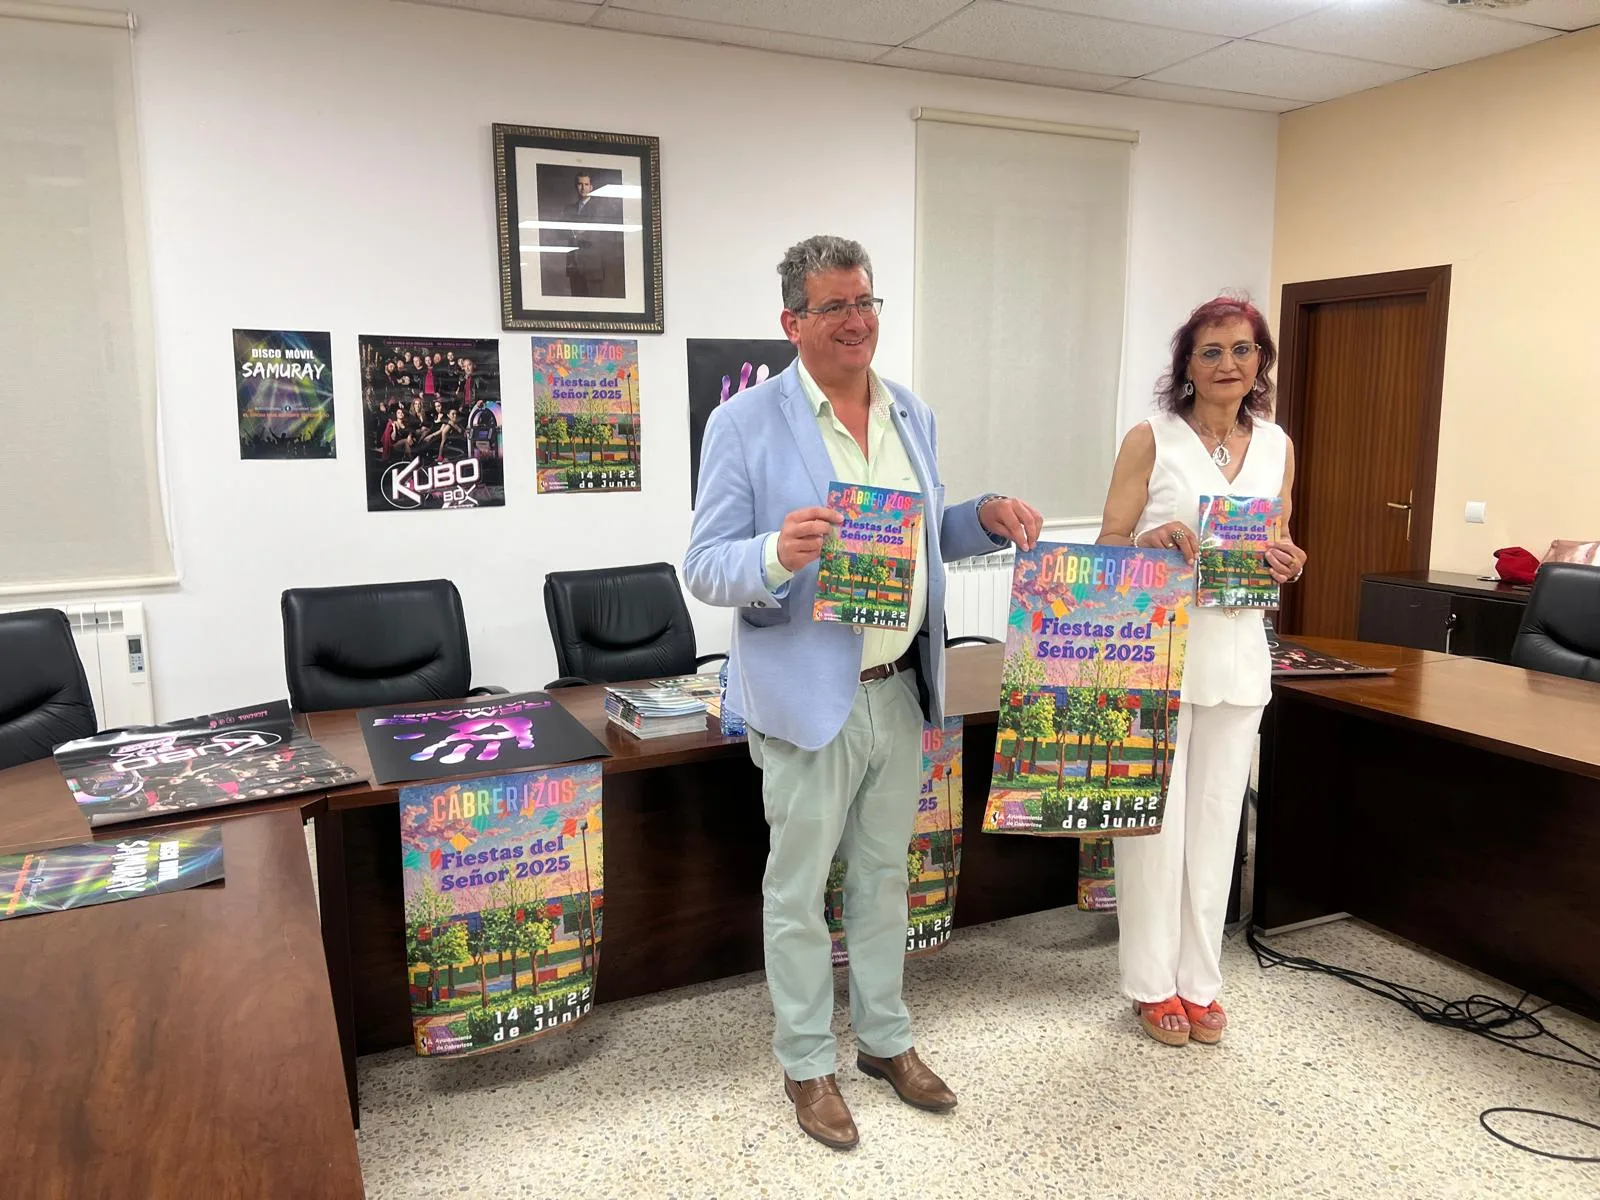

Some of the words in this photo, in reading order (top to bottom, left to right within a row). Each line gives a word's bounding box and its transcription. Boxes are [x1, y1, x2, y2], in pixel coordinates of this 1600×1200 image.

[251, 348, 282, 359] DISCO
[285, 348, 315, 359] MÓVIL
[547, 343, 624, 360] CABRERIZOS
[241, 361, 325, 380] SAMURAY
[553, 376, 597, 387] Fiestas
[599, 378, 619, 387] del
[552, 388, 589, 399] Señor
[592, 390, 622, 399] 2025
[391, 456, 479, 505] KUBO
[580, 470, 594, 479] 14
[601, 470, 613, 479] al
[619, 470, 635, 479] 22
[579, 480, 595, 488] de
[601, 480, 637, 488] Junio
[443, 484, 479, 505] BOX
[843, 488, 913, 511] CABRERIZOS
[843, 519, 882, 531] Fiestas
[884, 525, 903, 534] del
[1214, 523, 1249, 532] Fiestas
[1250, 524, 1266, 532] del
[841, 530, 875, 542] Señor
[876, 534, 905, 545] 2025
[1243, 533, 1269, 541] 2025
[1041, 554, 1169, 588] CABRERIZOS
[1263, 592, 1277, 600] 22
[1248, 600, 1278, 608] Junio
[855, 606, 868, 614] 14
[874, 608, 885, 617] al
[891, 610, 907, 619] 22
[852, 615, 866, 624] de
[873, 617, 907, 628] Junio
[1040, 617, 1115, 638] Fiestas
[1120, 622, 1154, 640] del
[1036, 639, 1100, 660] Señor
[1104, 643, 1156, 662] 2025
[921, 779, 932, 793] el
[432, 778, 577, 822] CABRERIZOS
[919, 797, 938, 812] 25
[1067, 796, 1089, 811] 14
[1102, 796, 1121, 811] al
[1133, 796, 1158, 811] 22
[1062, 814, 1088, 829] de
[1100, 813, 1158, 829] Junio
[441, 842, 524, 871] Fiestas
[530, 834, 565, 856] del
[440, 868, 510, 892] Señor
[515, 855, 571, 880] 2025
[907, 922, 923, 937] al
[934, 915, 951, 932] 22
[906, 930, 951, 951] Junio
[495, 1007, 519, 1024] 14
[534, 998, 553, 1016] al
[567, 986, 591, 1006] 22
[493, 1027, 520, 1042] de
[534, 1001, 591, 1032] Junio
